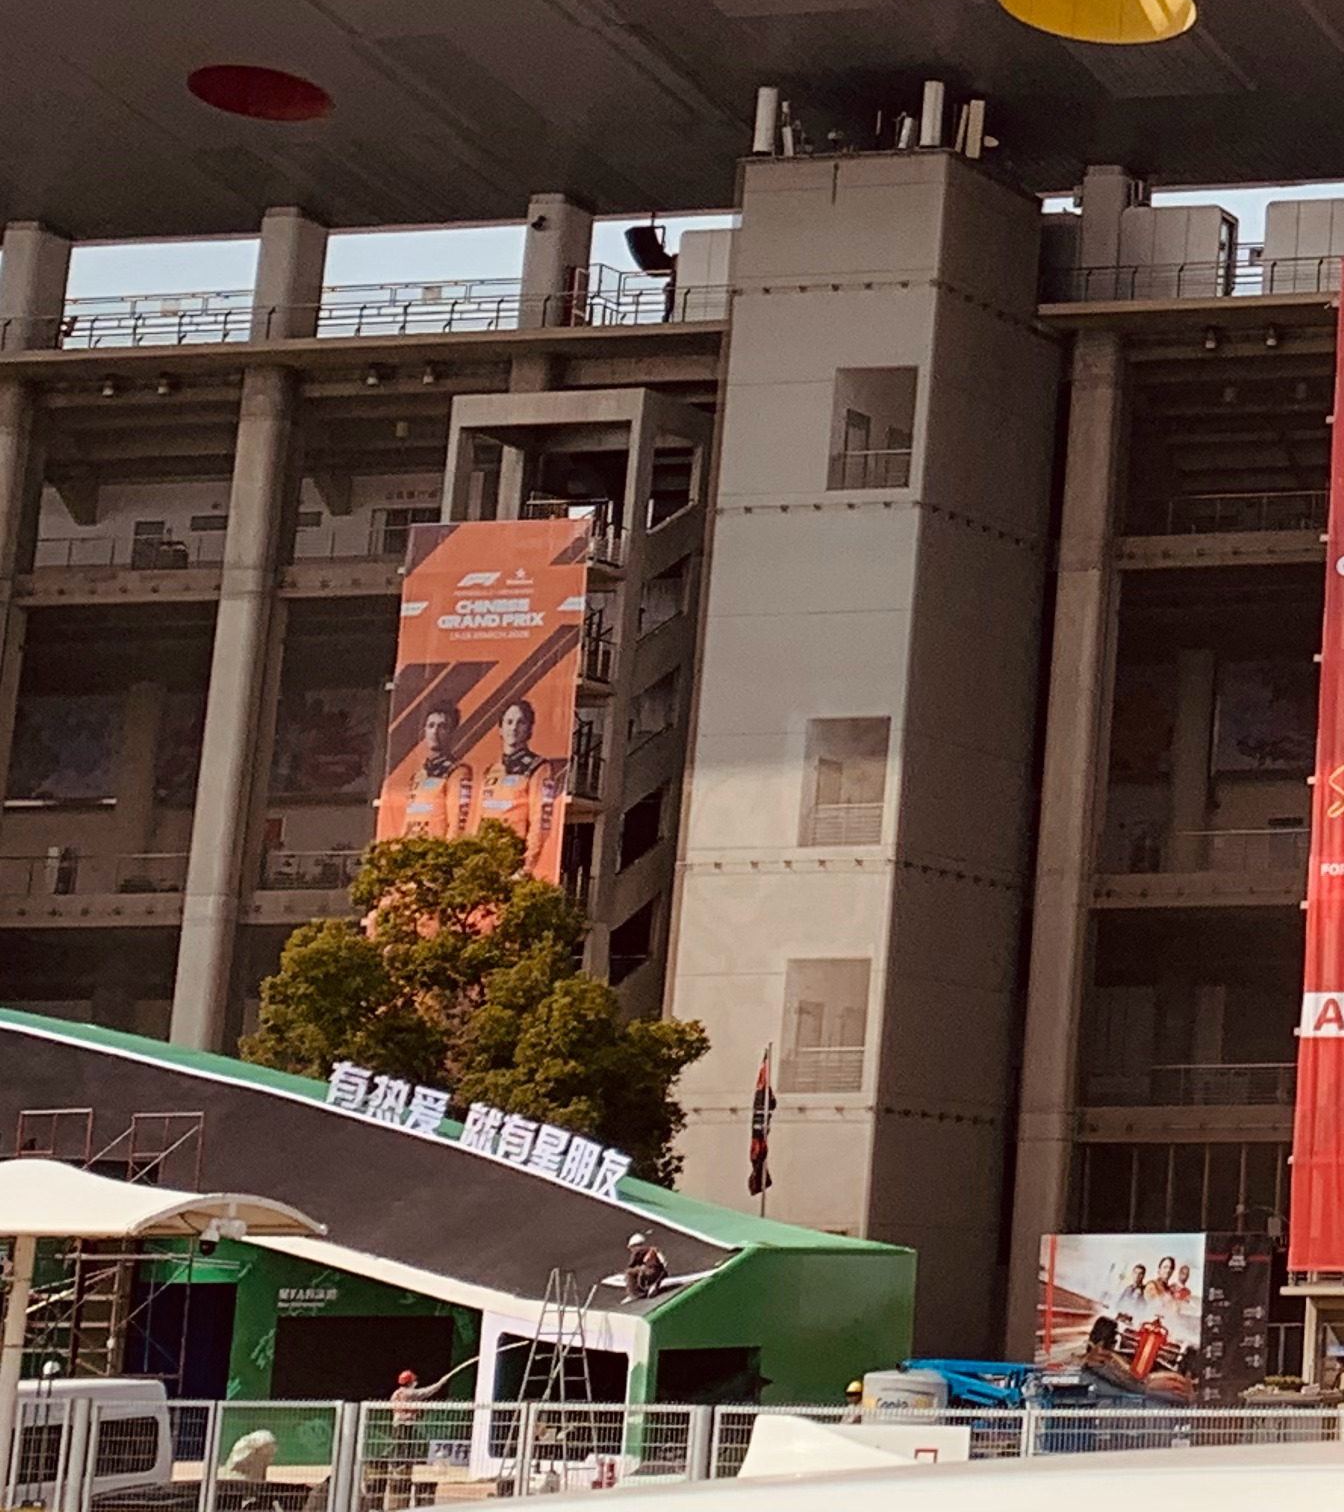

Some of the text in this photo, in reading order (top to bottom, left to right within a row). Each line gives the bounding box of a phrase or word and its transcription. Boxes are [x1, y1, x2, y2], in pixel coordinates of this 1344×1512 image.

[437, 611, 545, 628] GRAND PRIX
[326, 1061, 633, 1201] 有热爱 就有星朋友
